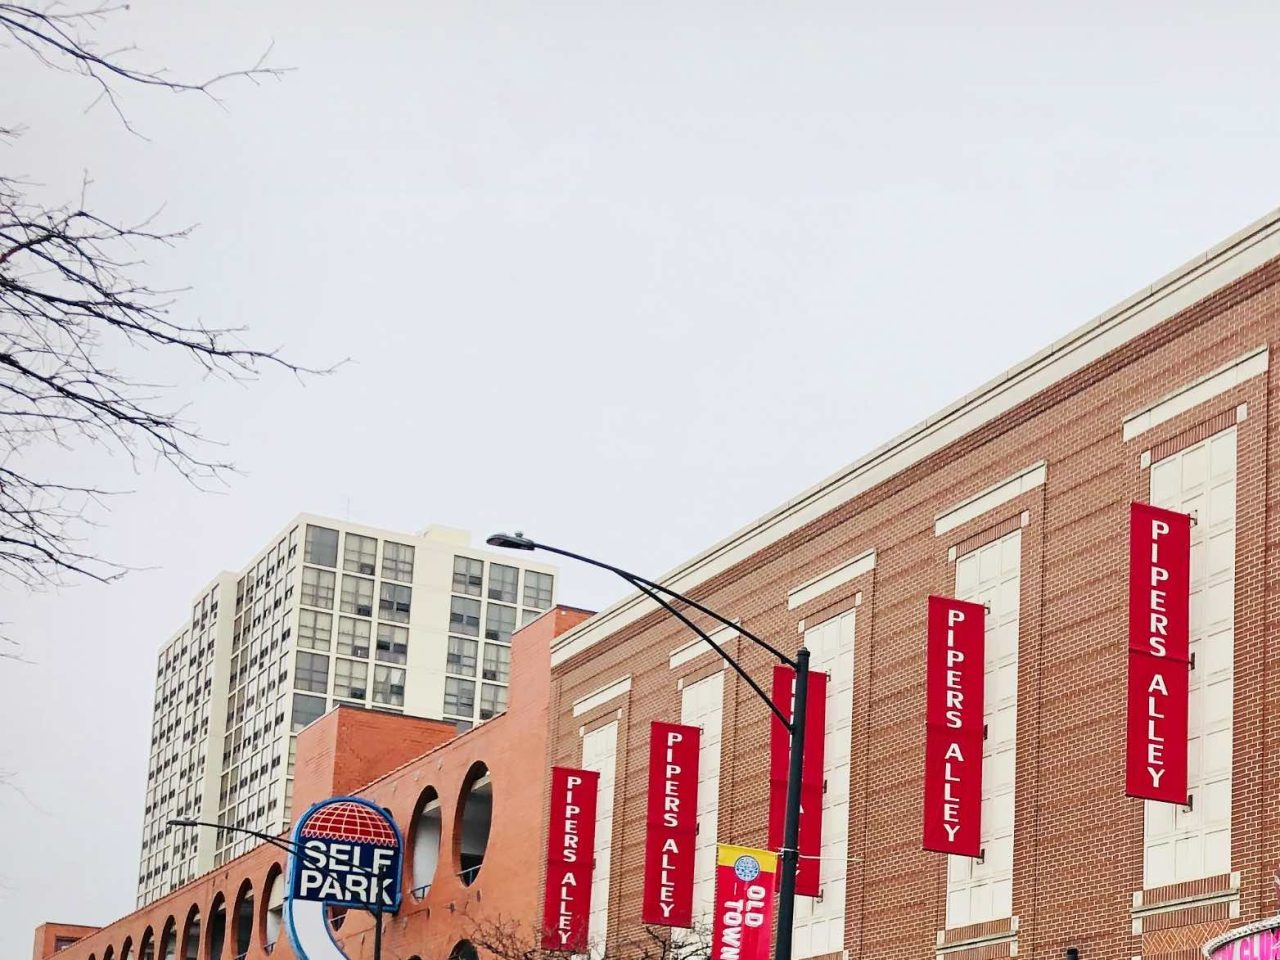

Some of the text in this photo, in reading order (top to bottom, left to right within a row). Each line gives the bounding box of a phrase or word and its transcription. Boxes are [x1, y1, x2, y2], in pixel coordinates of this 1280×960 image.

[1147, 519, 1169, 788] PIPERS ALLEY
[943, 609, 965, 843] PIPERS ALLEY
[303, 840, 394, 875] SELF
[558, 776, 582, 945] PIPERS ALLEY
[660, 732, 683, 918] PIPERS ALLEY
[300, 869, 393, 905] PARK
[720, 899, 743, 960] TOWN
[744, 885, 766, 928] OLD
